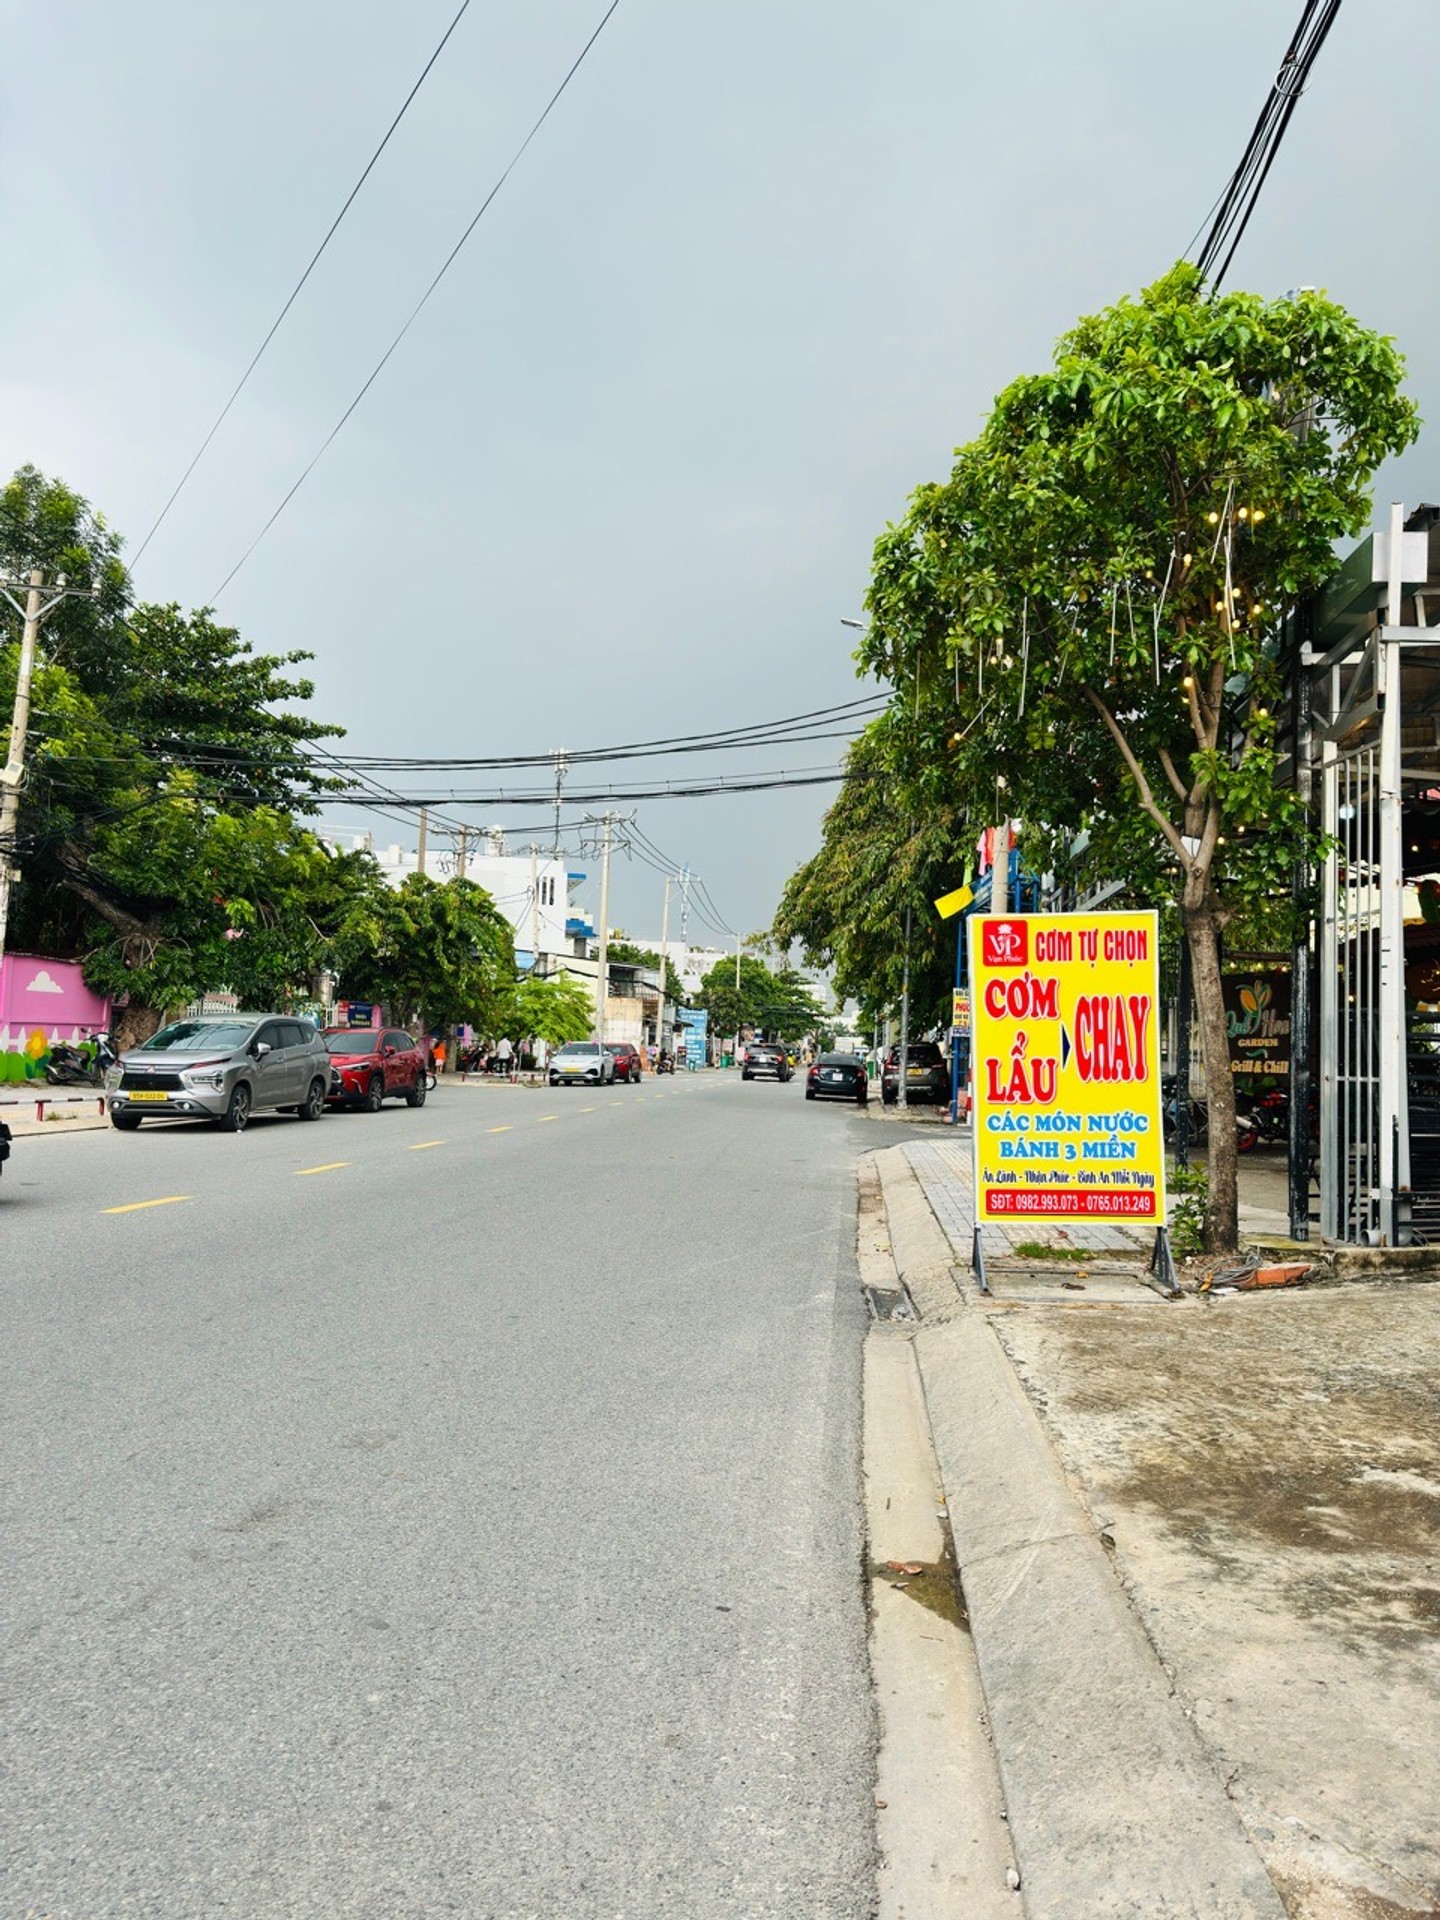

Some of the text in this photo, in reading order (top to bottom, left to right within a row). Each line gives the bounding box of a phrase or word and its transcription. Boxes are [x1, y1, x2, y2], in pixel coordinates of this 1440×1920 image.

[1035, 928, 1147, 968] CƠM TỰ CHỌN
[984, 970, 1058, 1019] CƠM
[1074, 995, 1149, 1081] CHAY
[986, 1031, 1057, 1102] LẨU
[987, 1111, 1149, 1132] CÁC MÓN NƯỚC
[1000, 1134, 1136, 1160] BÁNH 3 MIỀN
[1015, 1193, 1079, 1211] 0982.993.073
[1087, 1195, 1151, 1212] 0765.013.249
